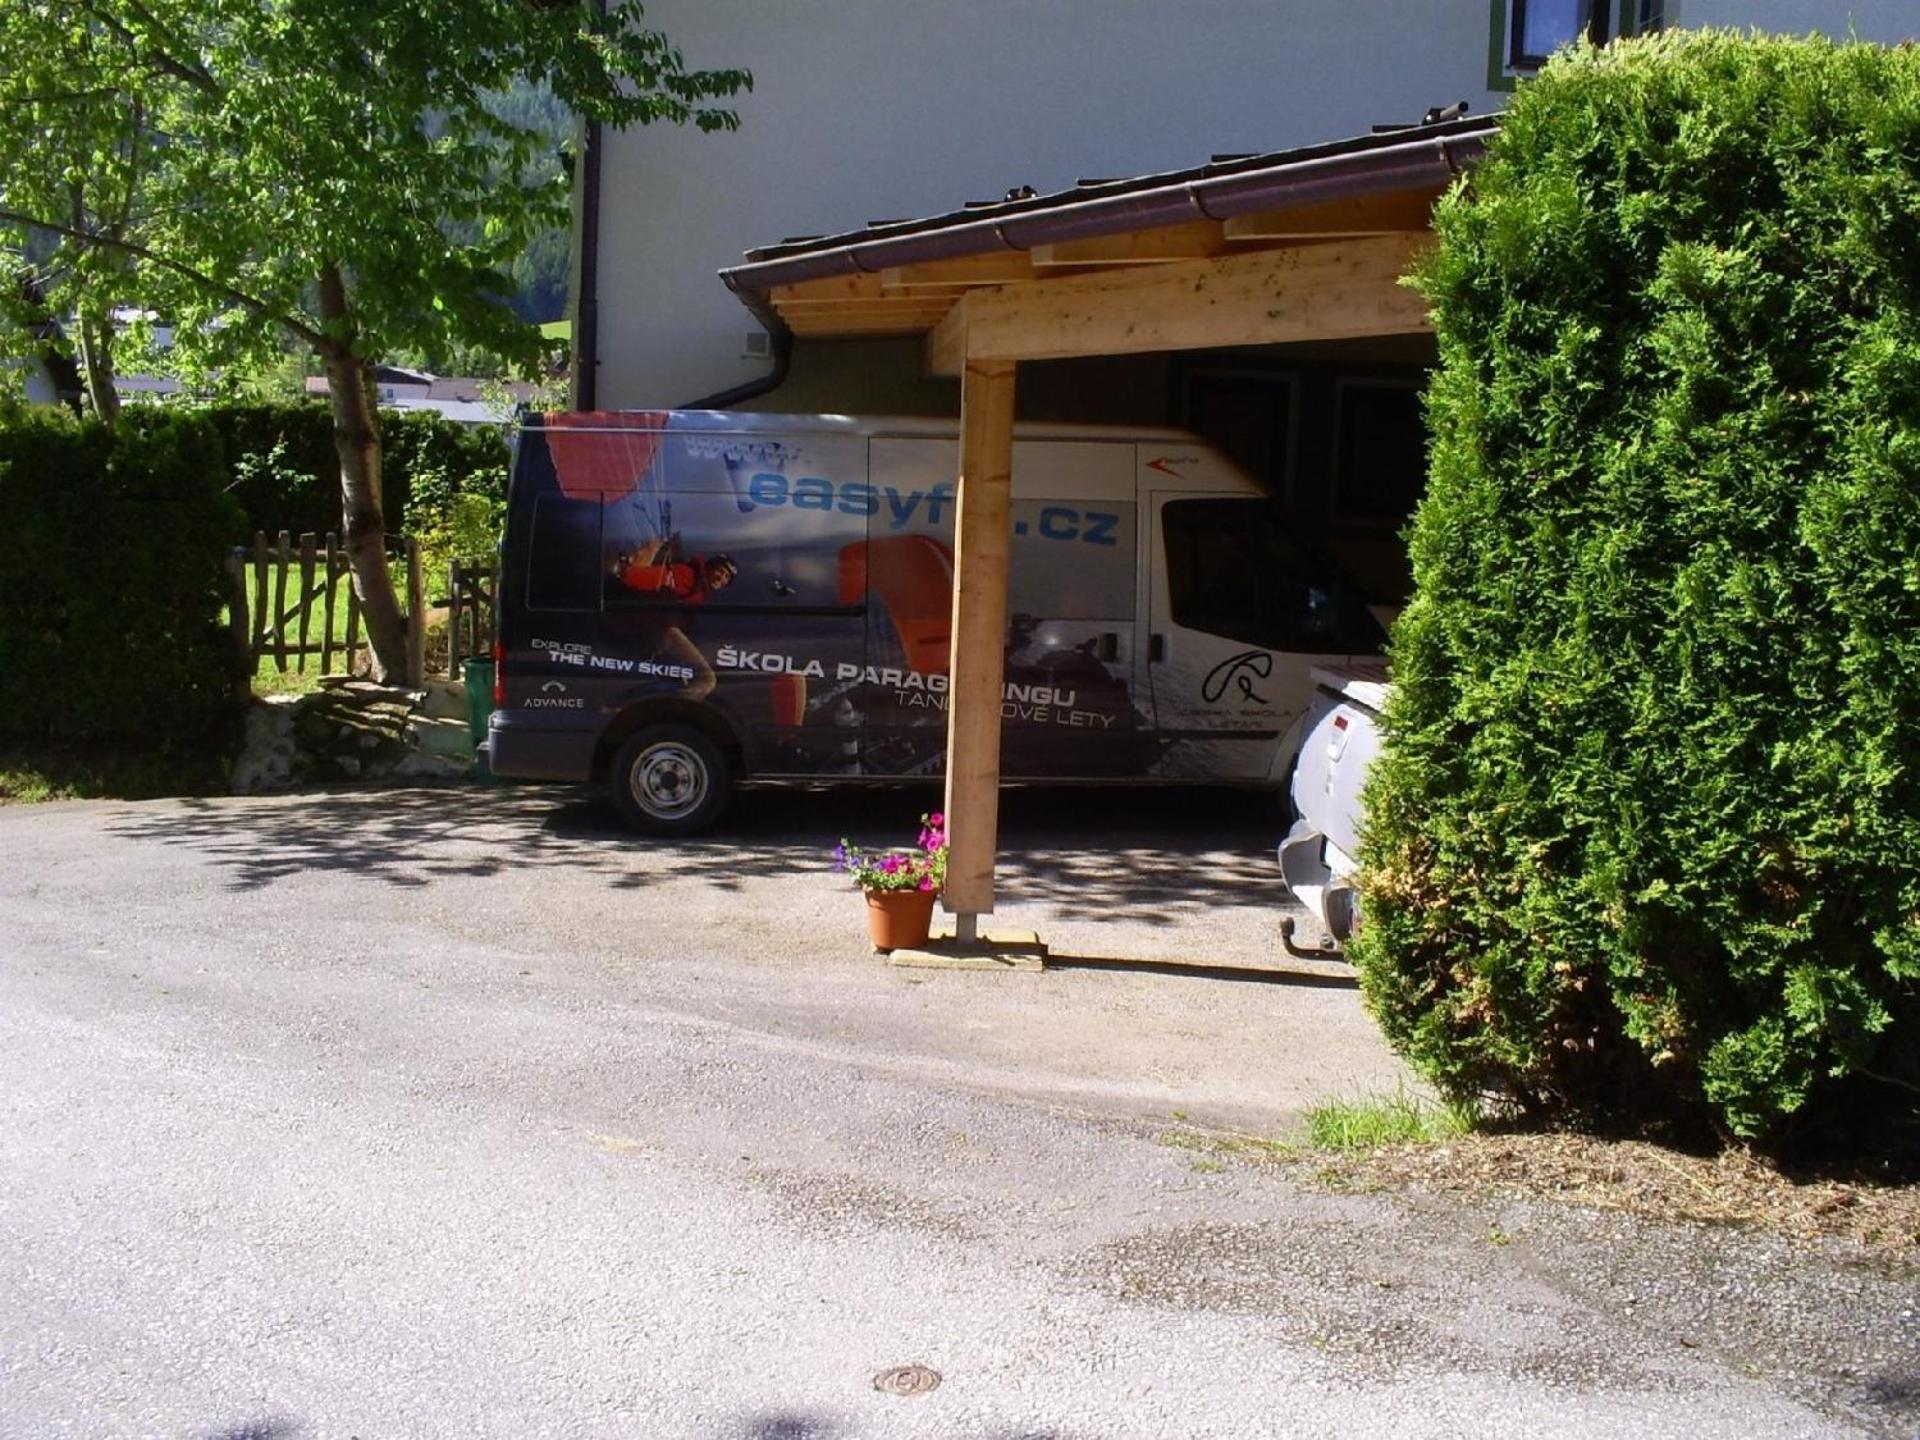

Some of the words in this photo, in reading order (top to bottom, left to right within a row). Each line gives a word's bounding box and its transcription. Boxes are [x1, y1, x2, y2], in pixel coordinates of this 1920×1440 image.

[749, 472, 1119, 546] easyf.cz
[531, 638, 593, 655] EXPLORE
[549, 650, 586, 666] THE
[590, 656, 634, 671] NEW
[638, 661, 694, 679] SKIES
[716, 645, 825, 678] ŠKOLA
[524, 698, 585, 709] ADVANCE
[1057, 708, 1117, 728] LETY
